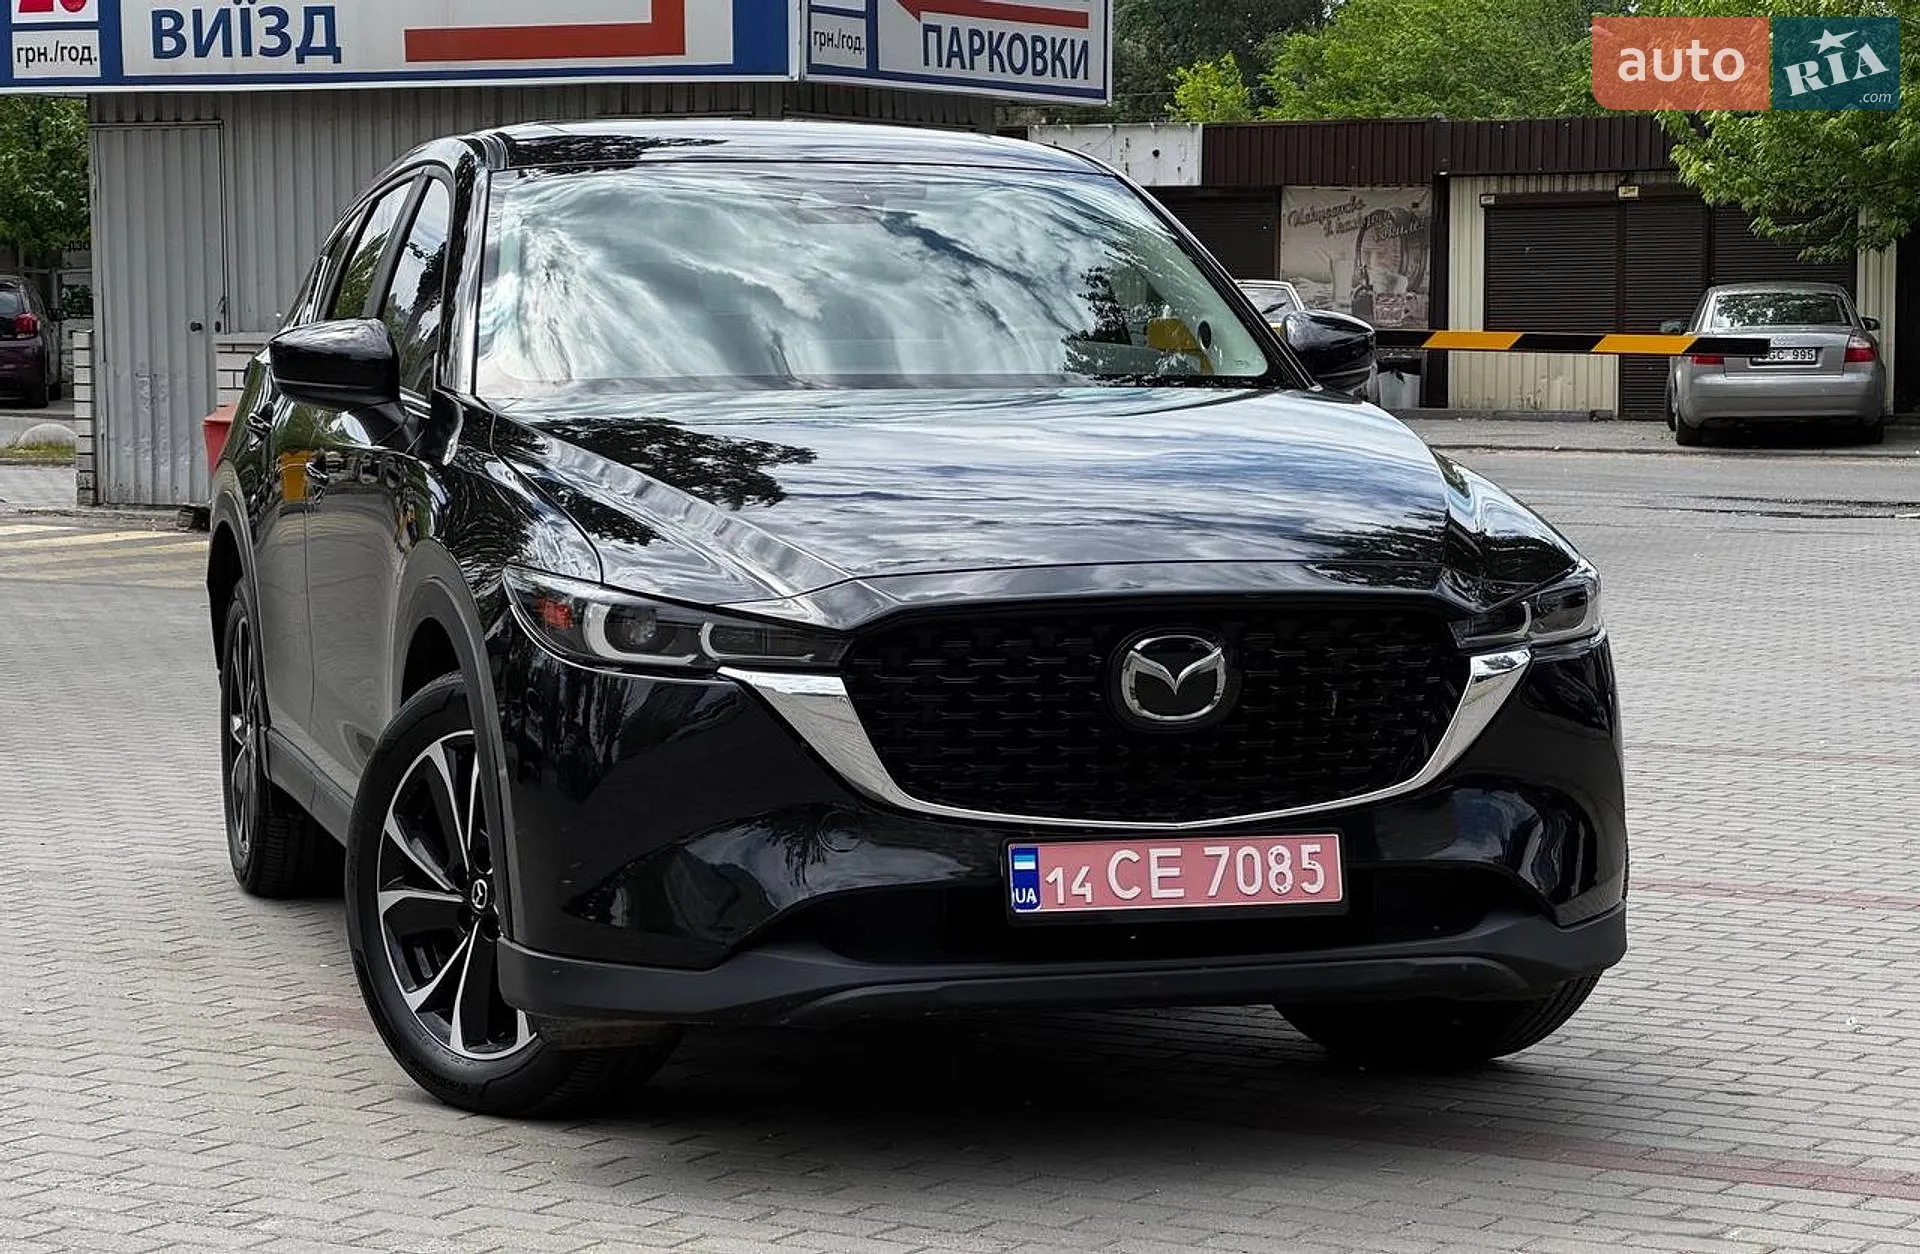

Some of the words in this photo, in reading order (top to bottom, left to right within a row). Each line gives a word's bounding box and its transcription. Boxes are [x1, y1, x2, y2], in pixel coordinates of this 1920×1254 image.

[151, 0, 341, 64] ВИЇЗД
[813, 28, 865, 54] грн./год.
[922, 23, 1090, 80] ПАРКОВКИ
[16, 40, 97, 68] грн./год.
[1045, 866, 1094, 905] 14
[1107, 847, 1185, 900] CE
[1203, 844, 1326, 897] 7085
[1014, 888, 1038, 904] UA
